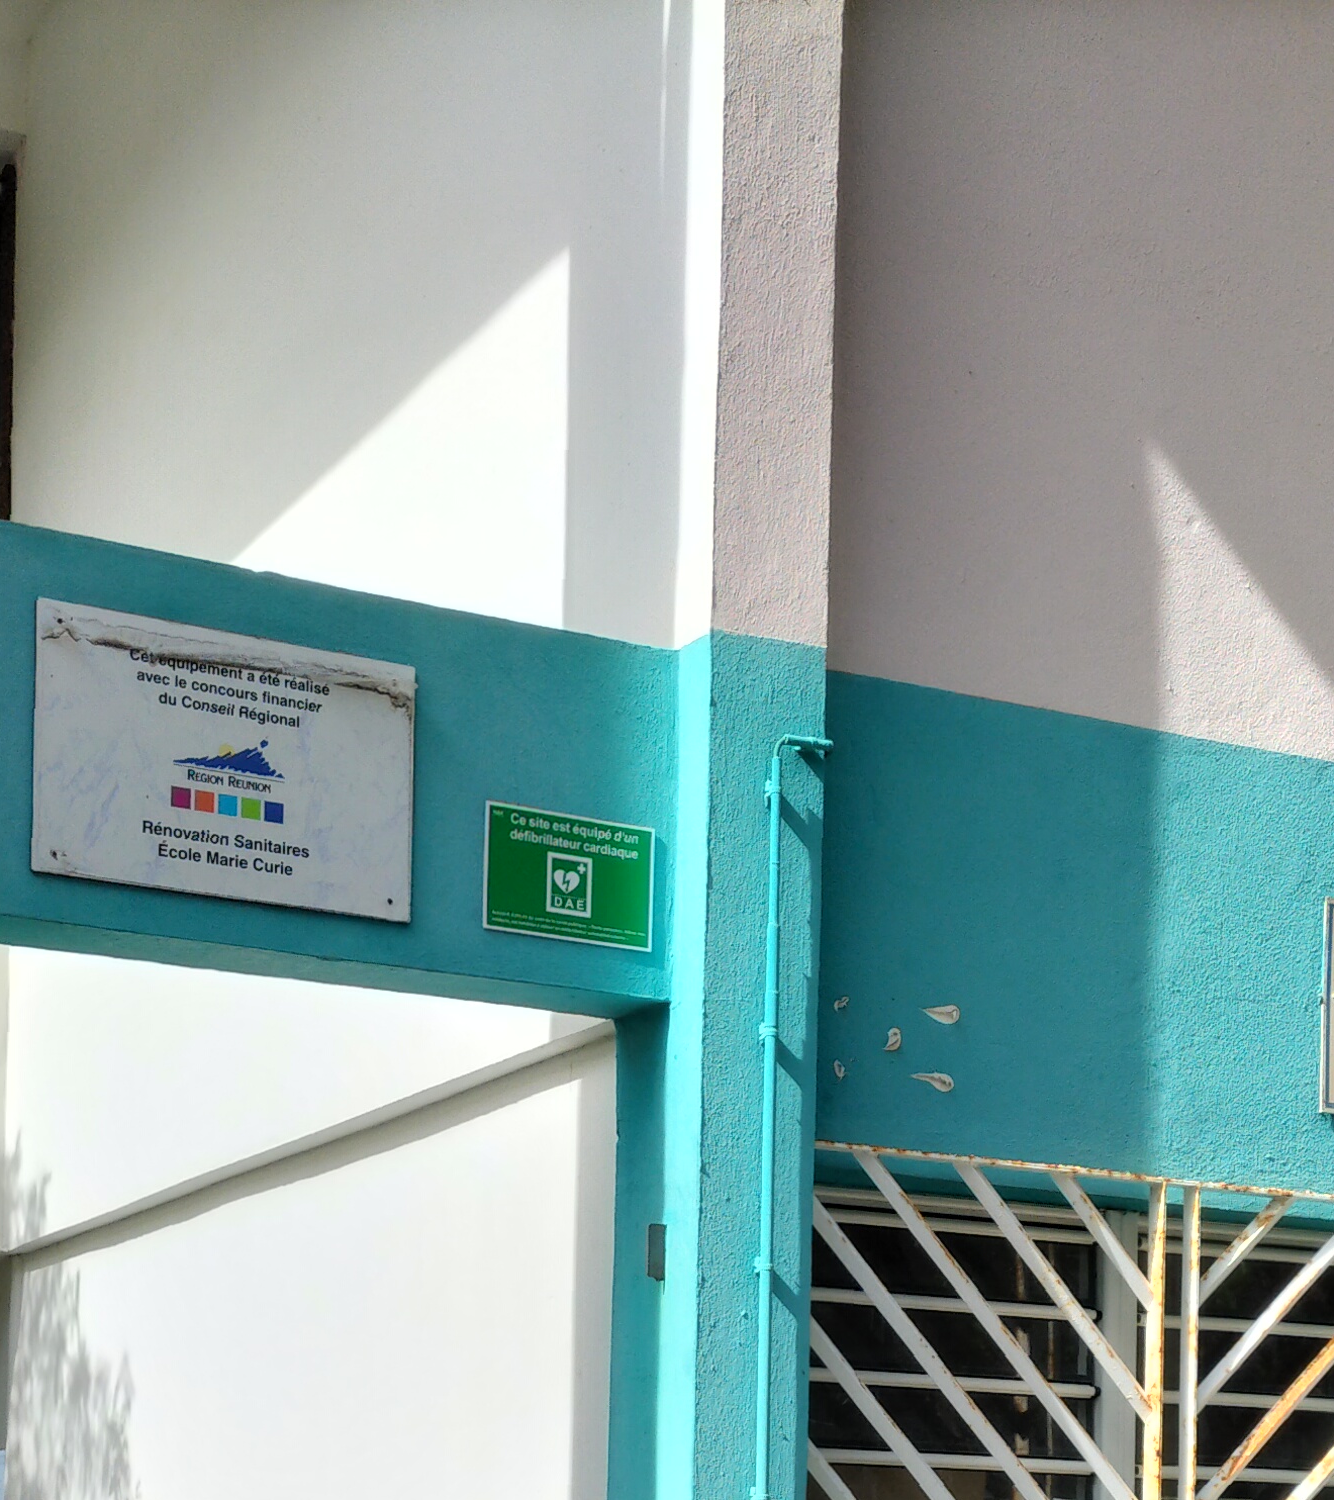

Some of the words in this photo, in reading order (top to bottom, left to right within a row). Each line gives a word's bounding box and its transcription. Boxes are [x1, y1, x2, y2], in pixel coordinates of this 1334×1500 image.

[129, 648, 156, 664] Cet
[246, 671, 255, 682] a
[259, 670, 281, 687] été
[284, 676, 331, 696] réalisé
[136, 670, 170, 686] avec
[175, 674, 187, 689] le
[191, 681, 258, 701] concours
[262, 690, 322, 714] financier
[158, 692, 177, 706] du
[181, 695, 235, 717] Conseil
[239, 706, 300, 728] Régional
[142, 820, 229, 846] Rénovation
[234, 834, 310, 859] Sanitaires
[509, 828, 582, 850] défibrillateur
[583, 841, 639, 861] cardiaque
[510, 812, 527, 826] Ce
[528, 815, 551, 830] site
[552, 821, 571, 834] est
[572, 823, 612, 841] équipé
[613, 831, 640, 845] d'un
[158, 840, 202, 862] École
[206, 851, 249, 869] Marie
[253, 858, 293, 876] Curie
[554, 896, 585, 911] DAE
